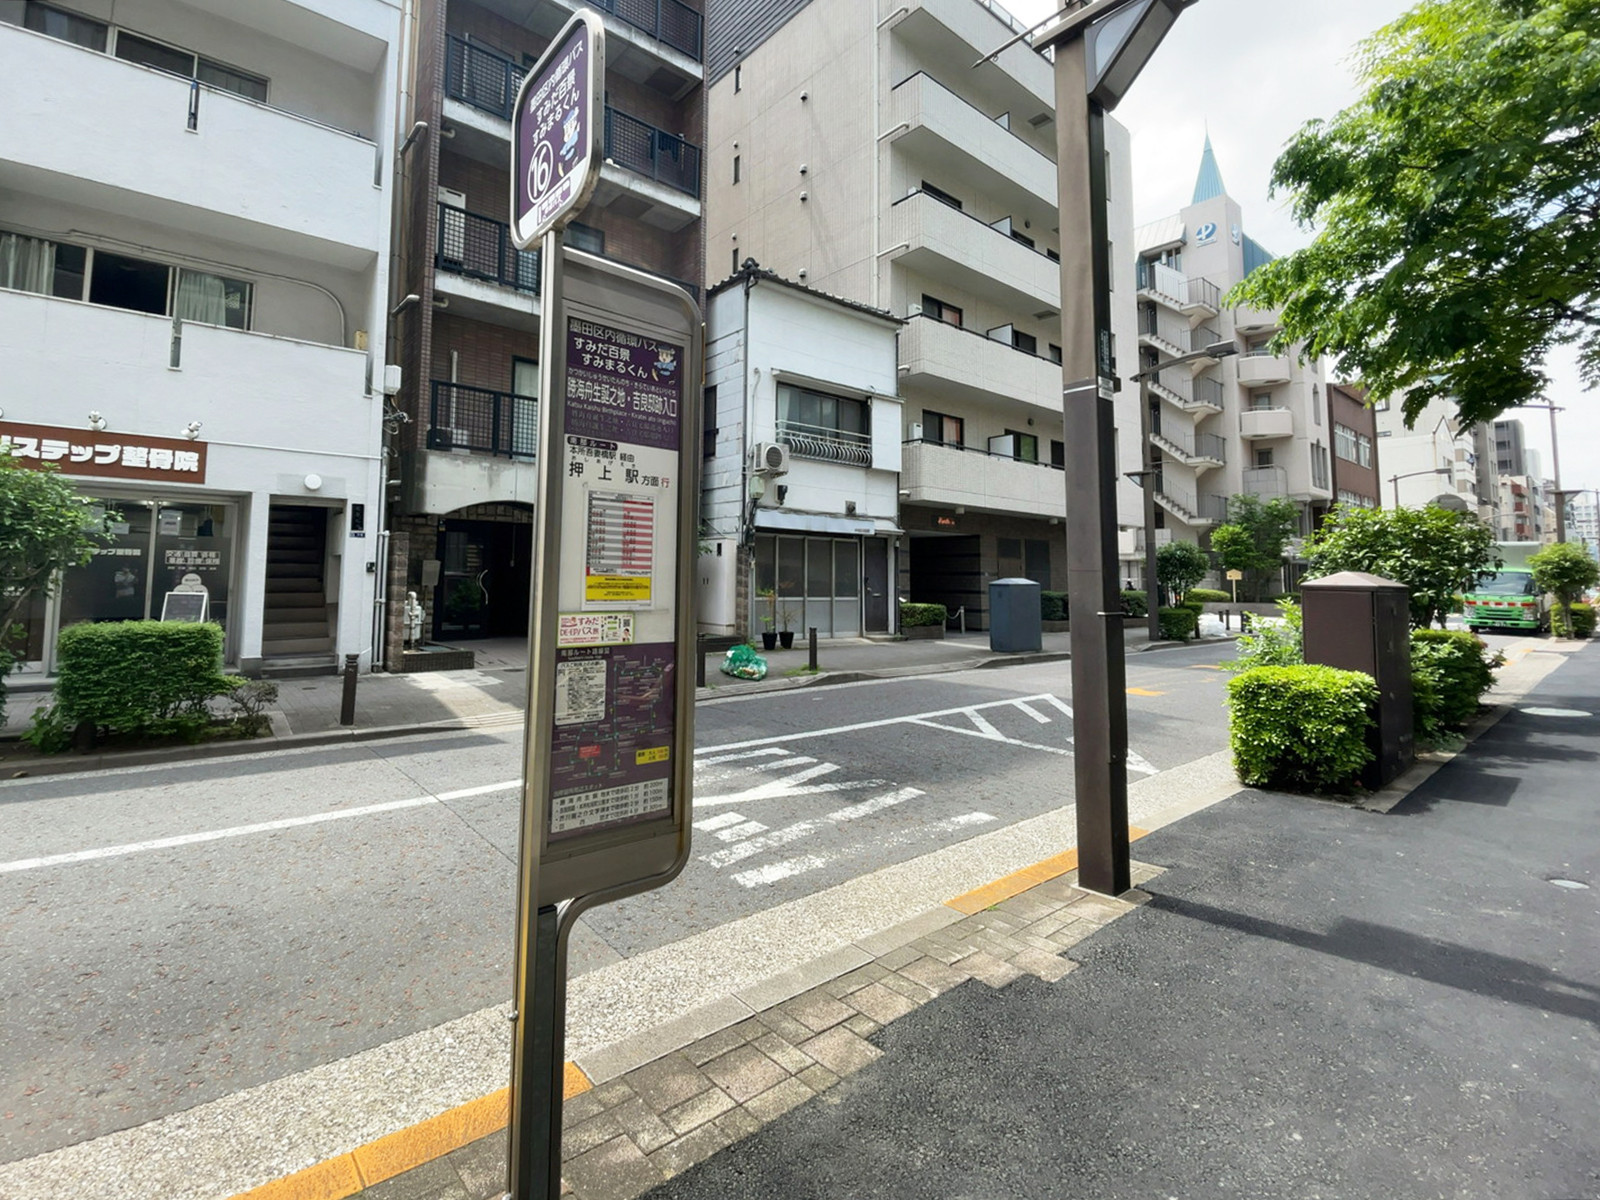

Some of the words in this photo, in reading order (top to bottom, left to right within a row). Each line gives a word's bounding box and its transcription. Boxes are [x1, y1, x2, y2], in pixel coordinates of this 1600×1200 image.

[536, 68, 576, 125] すみだ百景
[532, 87, 580, 147] すみまるくん
[569, 319, 658, 352] 墨田区内循環バス
[574, 337, 631, 361] すみだ百景
[581, 352, 648, 379] すみまるくん
